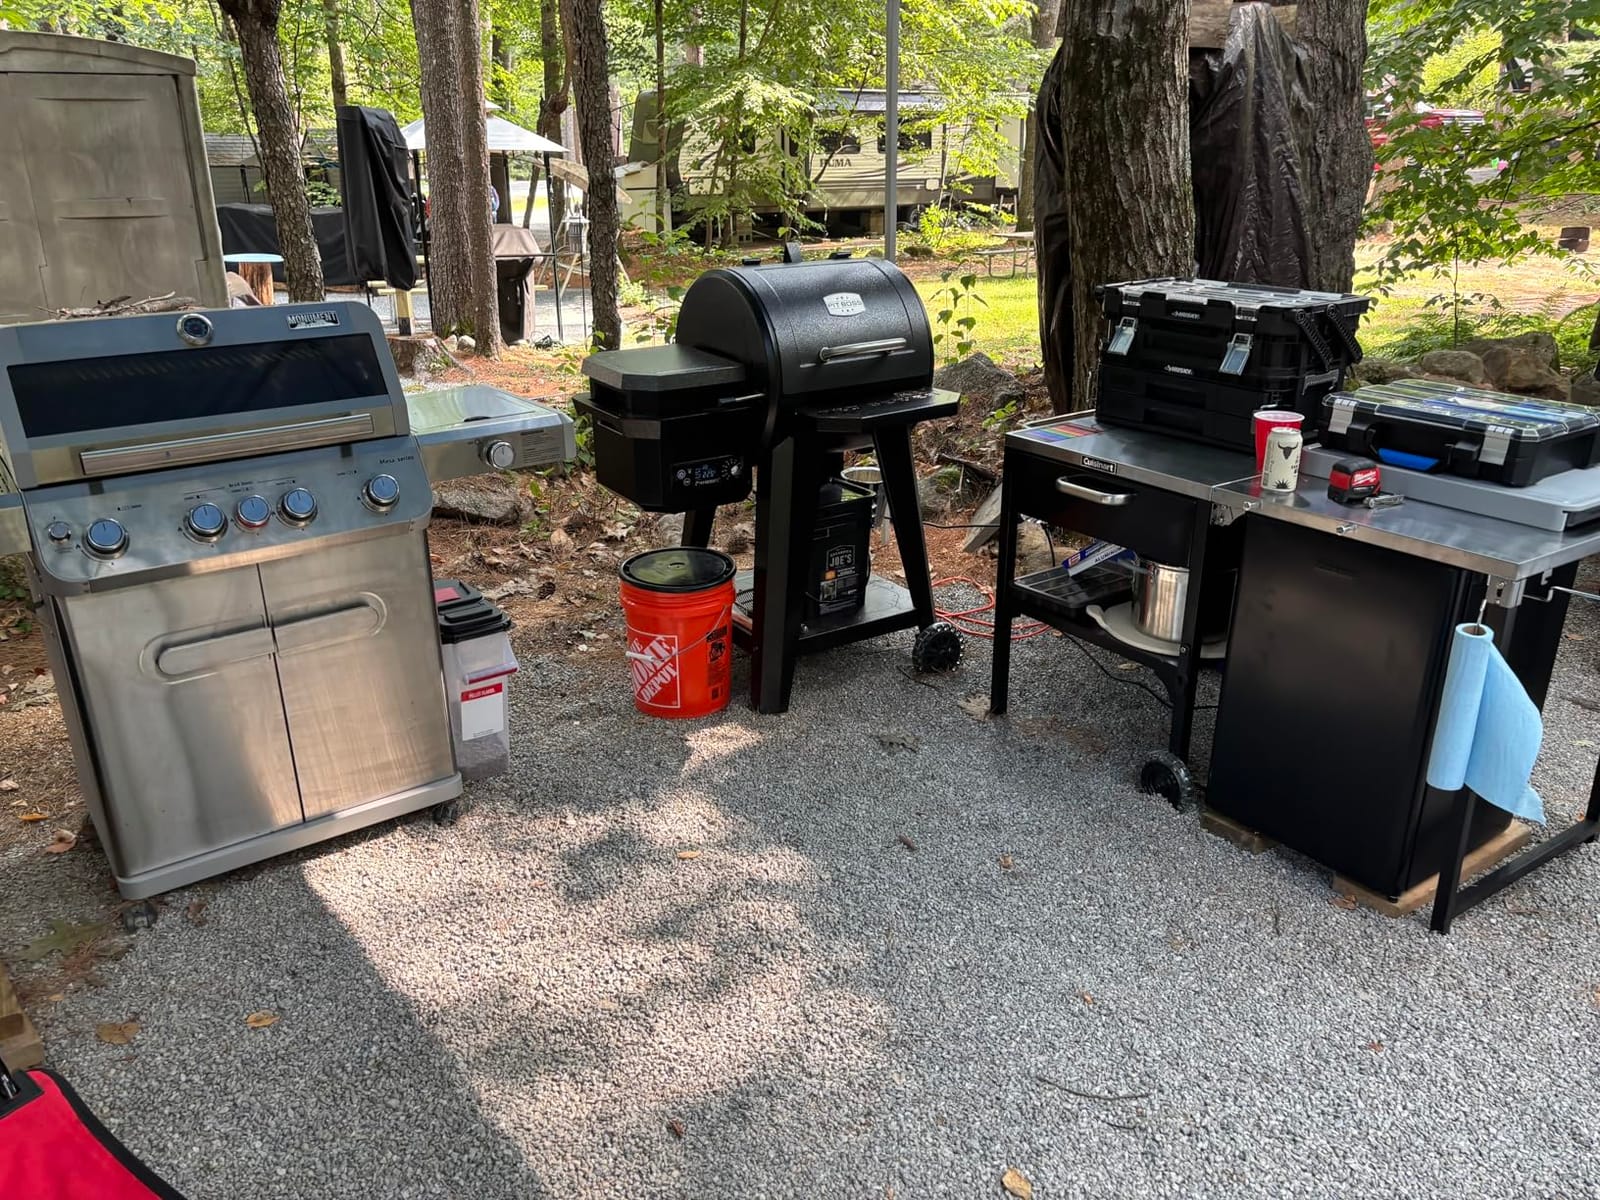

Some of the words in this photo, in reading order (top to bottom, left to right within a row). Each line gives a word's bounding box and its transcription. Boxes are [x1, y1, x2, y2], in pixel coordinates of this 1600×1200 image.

[820, 158, 852, 168] PUMA
[288, 311, 338, 324] MONUMENT
[1083, 457, 1114, 472] Cuisinart
[829, 553, 852, 567] JOE'S
[641, 662, 677, 703] DEPOT
